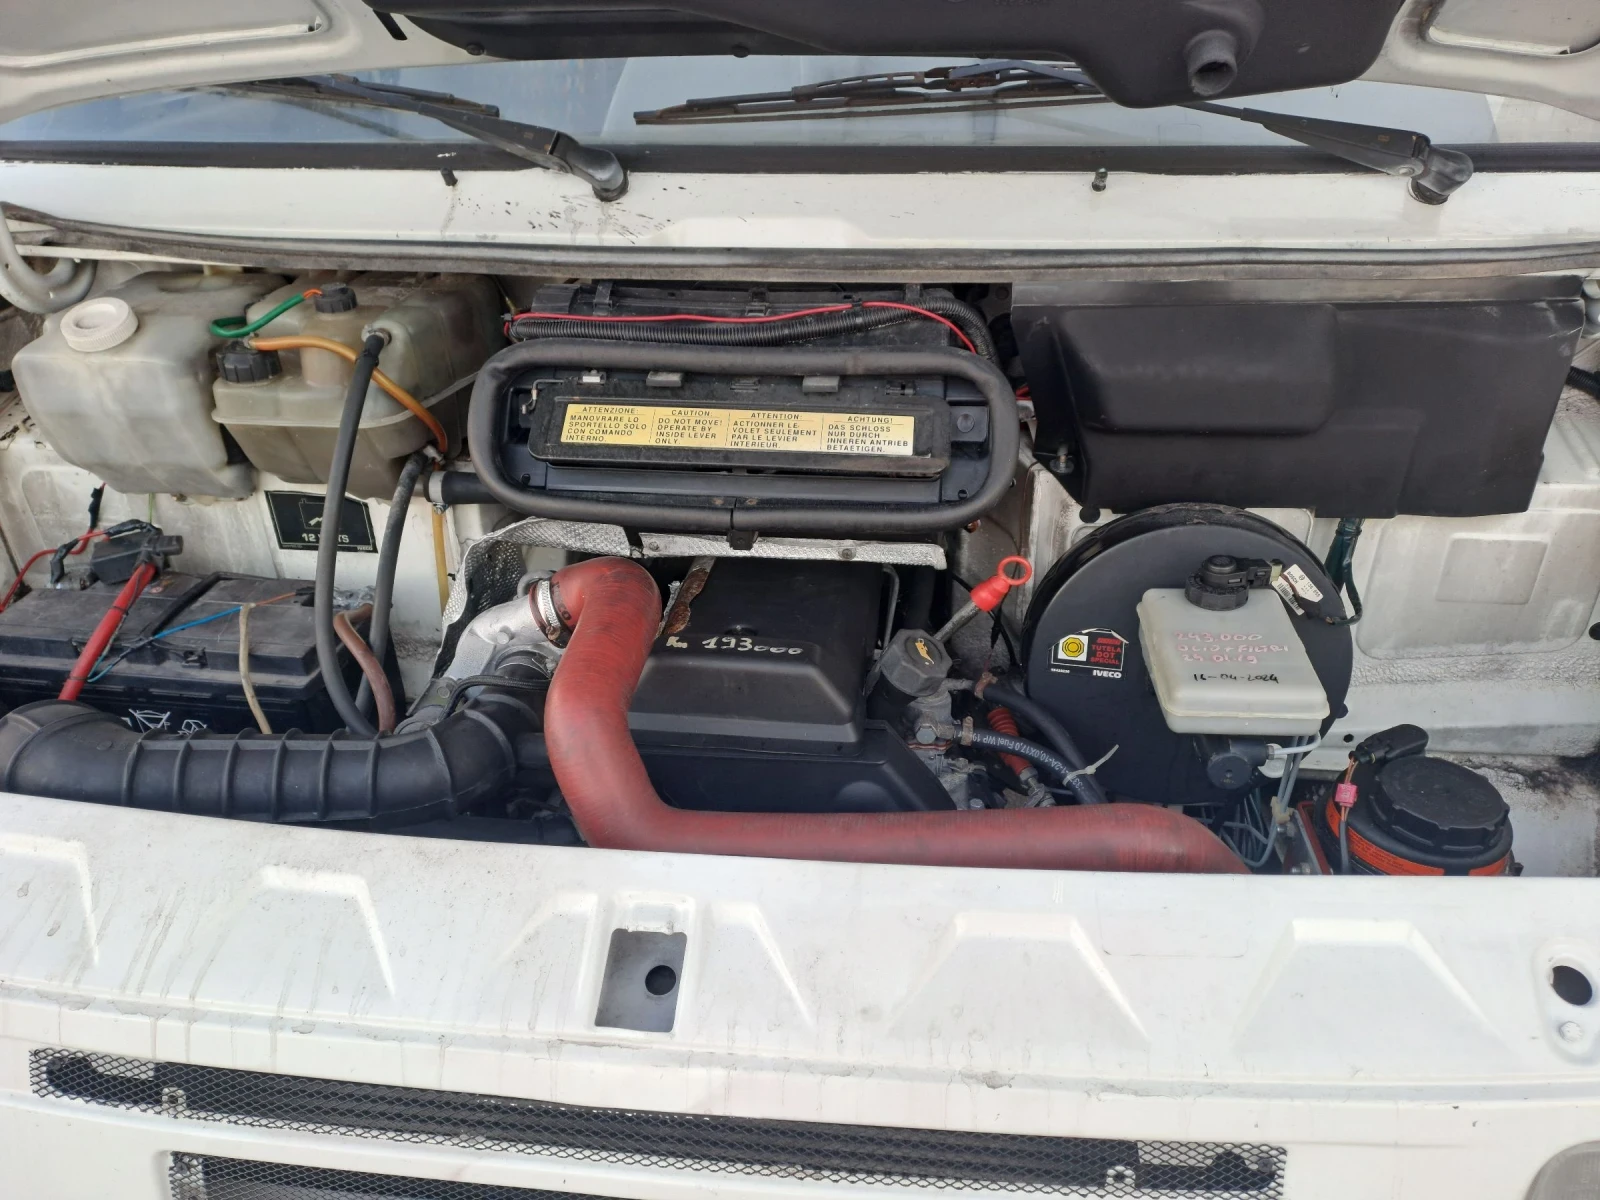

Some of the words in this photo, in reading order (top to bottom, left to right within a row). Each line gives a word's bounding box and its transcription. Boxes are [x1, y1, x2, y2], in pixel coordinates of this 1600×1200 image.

[569, 415, 624, 423] MANOVRARE
[847, 416, 893, 424] ACHTUNG!
[568, 421, 620, 429] SPORTELLO
[657, 424, 697, 432] OPERATE
[733, 420, 784, 428] ACTIONNER
[850, 424, 891, 432] SCHLOSS
[589, 428, 633, 436] COMANDO
[764, 428, 817, 436] SEULEMENT
[827, 437, 866, 445] INNEREN
[870, 439, 908, 447] ANTRIEB
[302, 533, 316, 542] 12
[702, 636, 803, 654] 193000
[1091, 644, 1122, 652] TUTELA
[1090, 657, 1120, 665] SPECIAL
[1092, 669, 1122, 679] IVECO
[982, 736, 996, 745] WP
[997, 737, 1014, 750] Fuel
